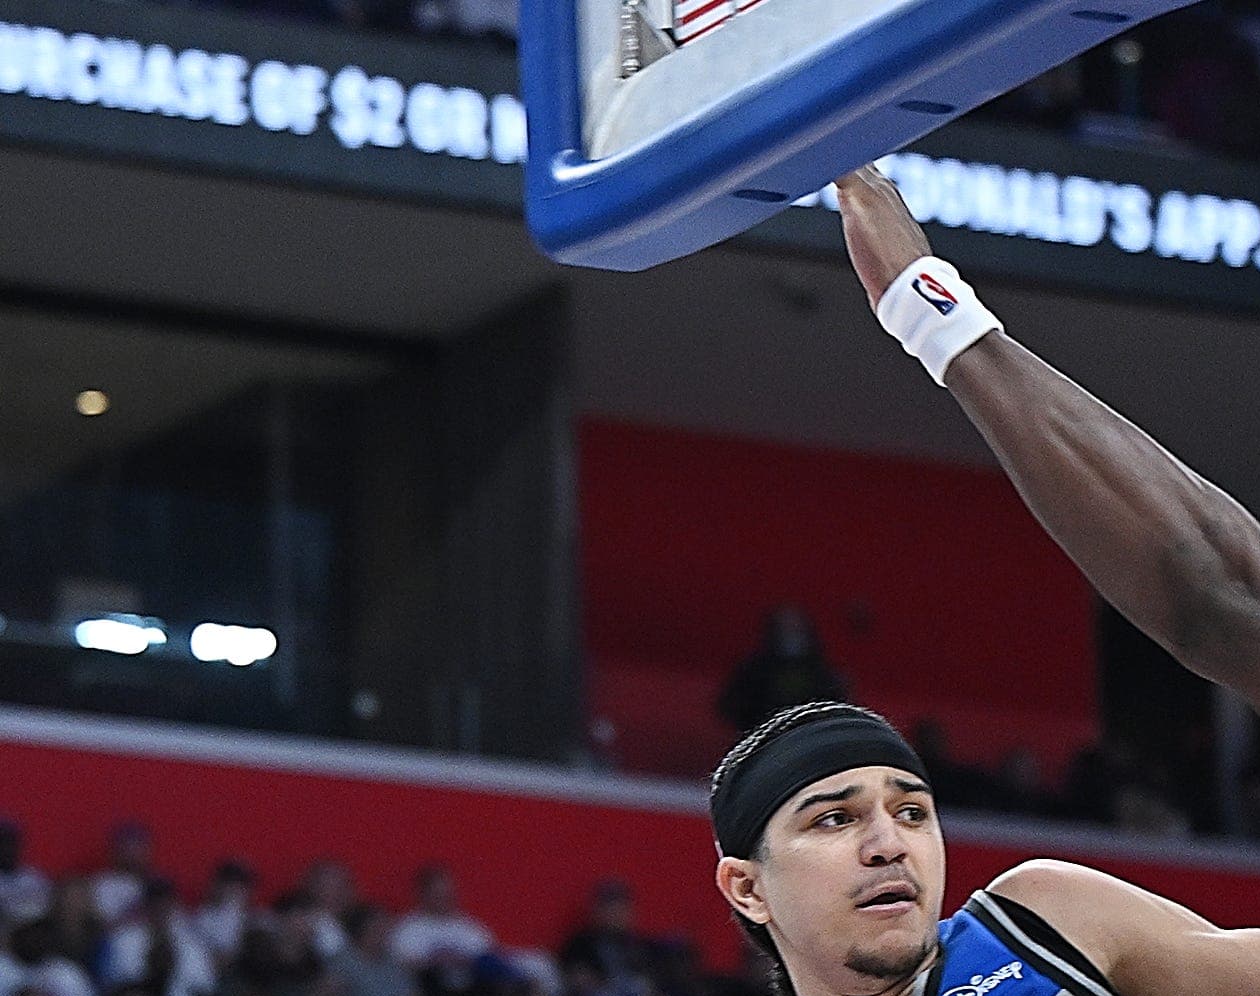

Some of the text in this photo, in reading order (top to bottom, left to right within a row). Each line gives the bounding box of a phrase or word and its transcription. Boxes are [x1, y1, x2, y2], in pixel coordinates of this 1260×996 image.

[0, 23, 248, 127] URCHASE
[250, 61, 327, 135] OF
[331, 66, 405, 149] $2
[406, 83, 489, 160] OR
[872, 152, 1152, 252] DONALD'S
